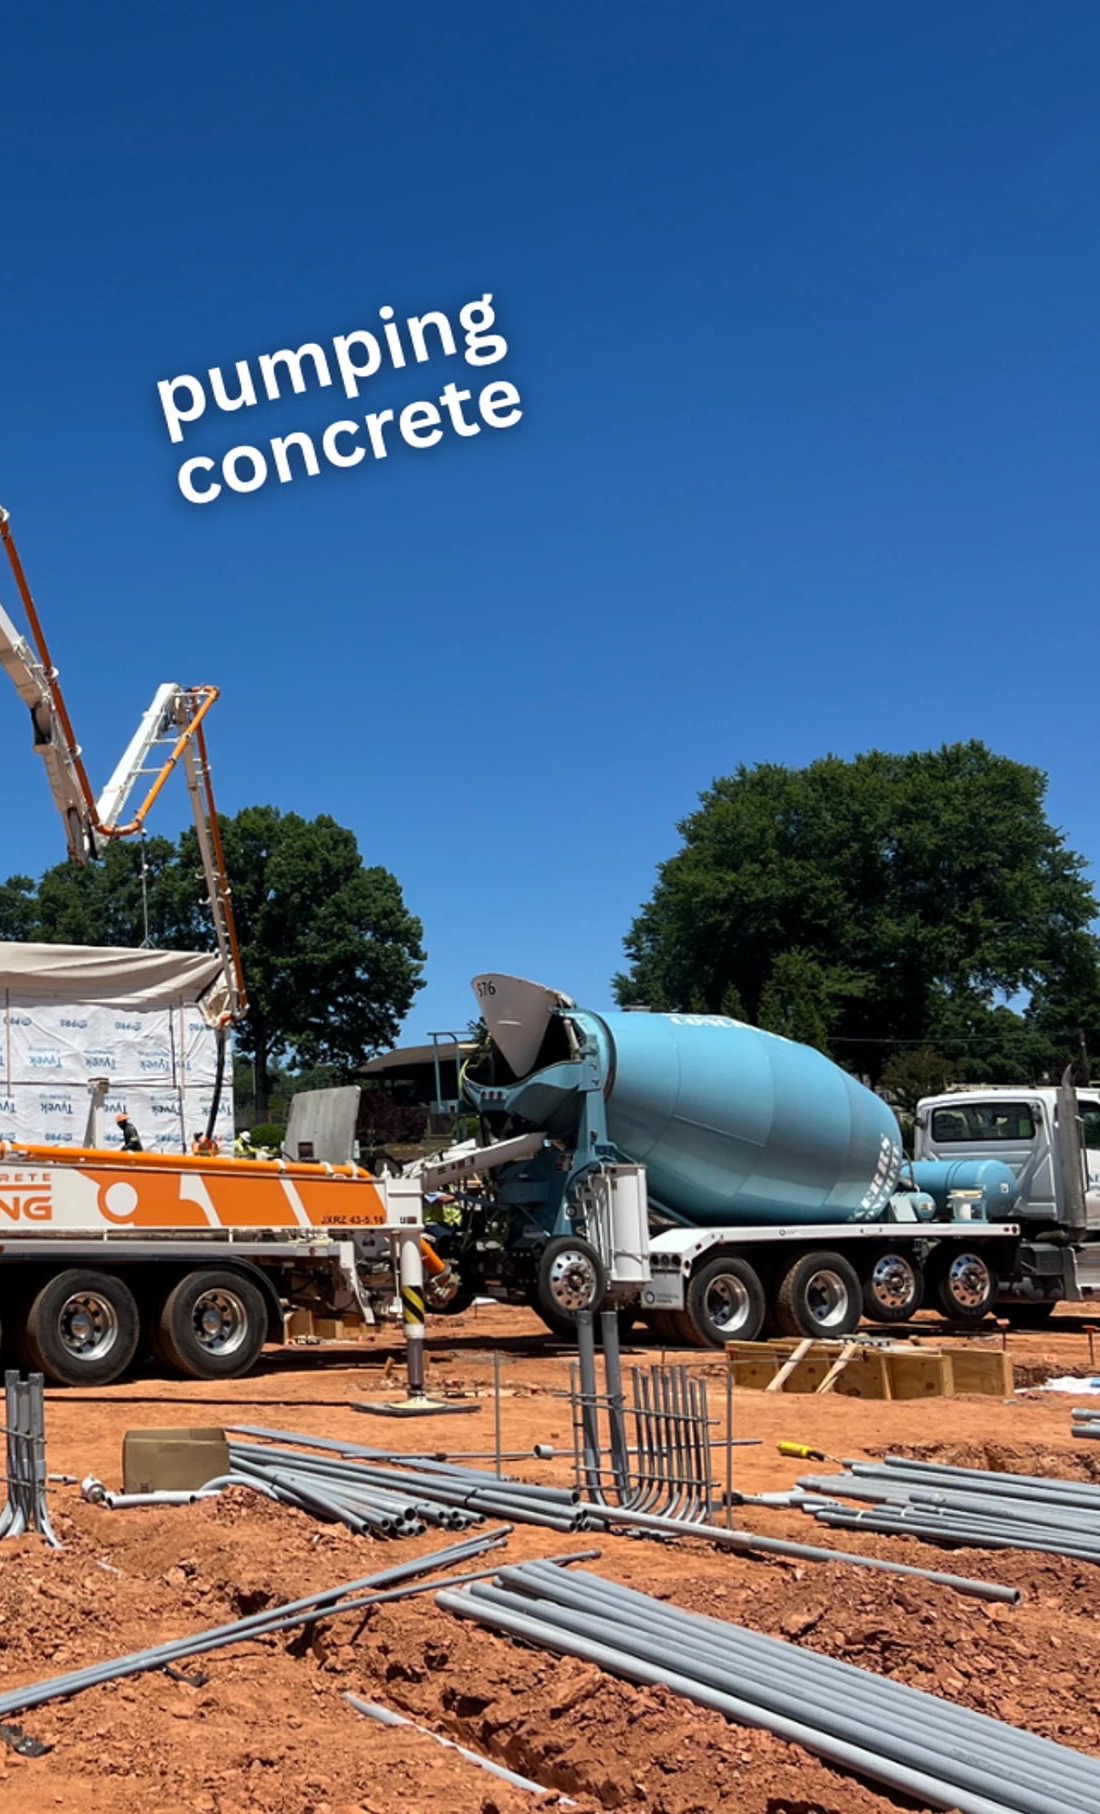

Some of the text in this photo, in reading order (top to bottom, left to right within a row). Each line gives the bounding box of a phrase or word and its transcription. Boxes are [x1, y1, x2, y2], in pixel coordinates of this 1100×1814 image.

[476, 980, 497, 998] 576
[30, 1055, 63, 1069] Tyvek
[40, 1102, 72, 1114] Tyvek
